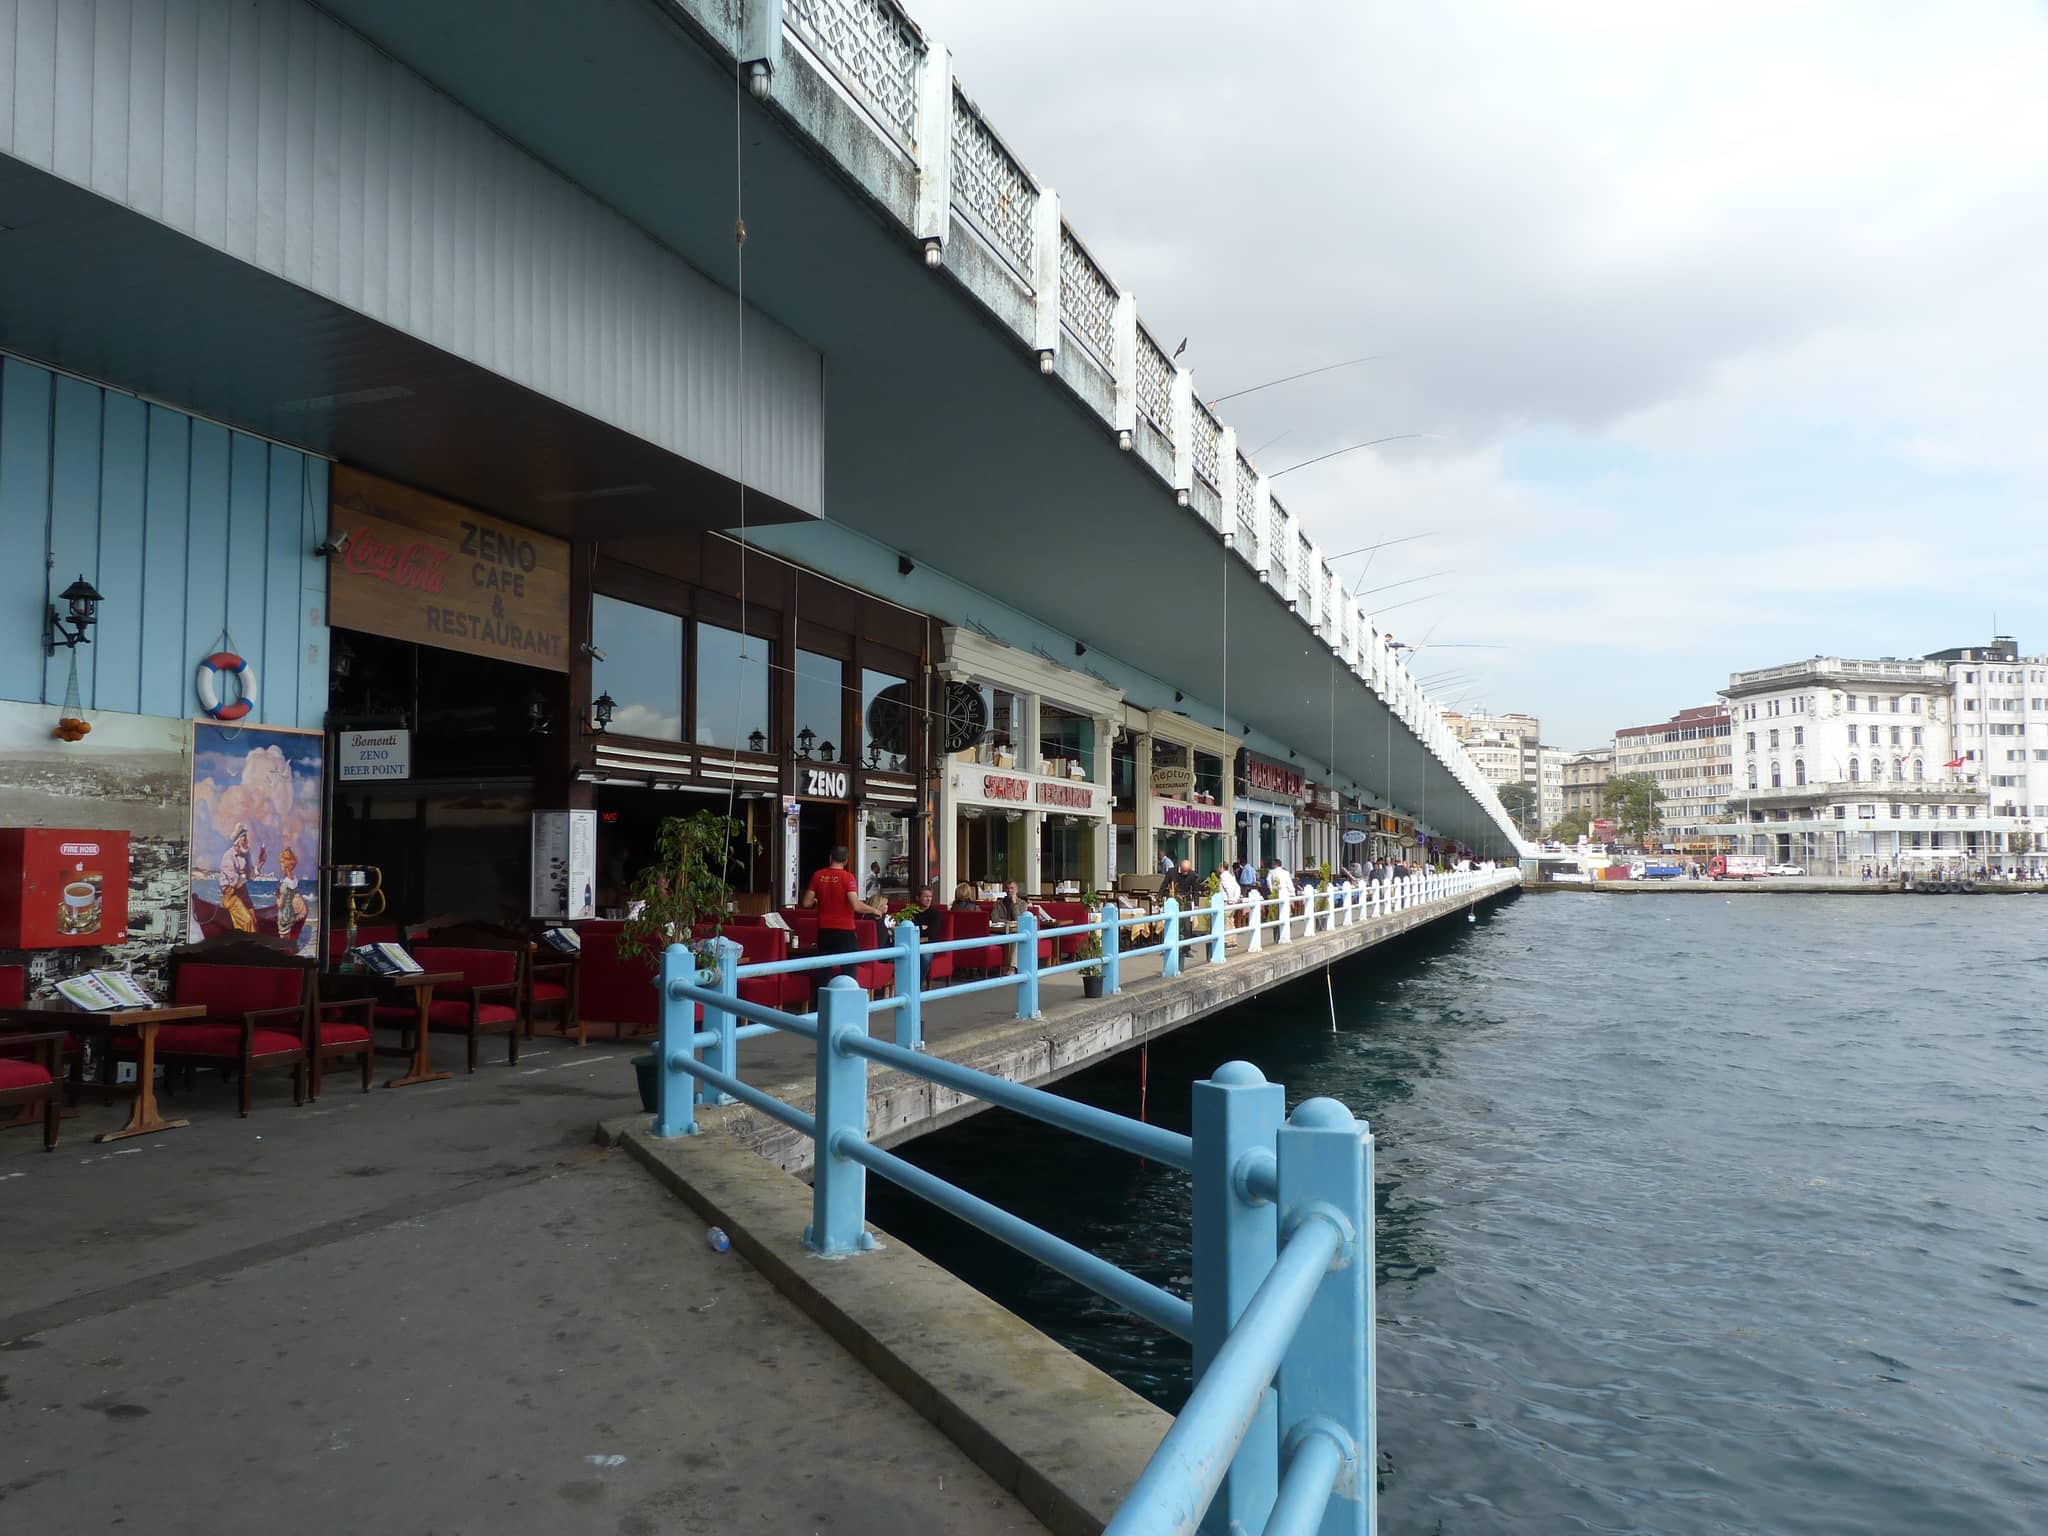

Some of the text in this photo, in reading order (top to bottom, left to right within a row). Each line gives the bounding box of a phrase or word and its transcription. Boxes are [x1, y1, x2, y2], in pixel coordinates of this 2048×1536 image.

[459, 520, 537, 573] ZENO
[472, 562, 525, 598] CAFE
[491, 594, 504, 618] &
[426, 605, 561, 657] RESTAURANT
[352, 734, 397, 747] Bomonti
[360, 750, 389, 760] ZENO
[344, 764, 405, 776] BEER POINT
[808, 769, 847, 799] ZENO
[984, 774, 1093, 809] SARAY RESTAURANT
